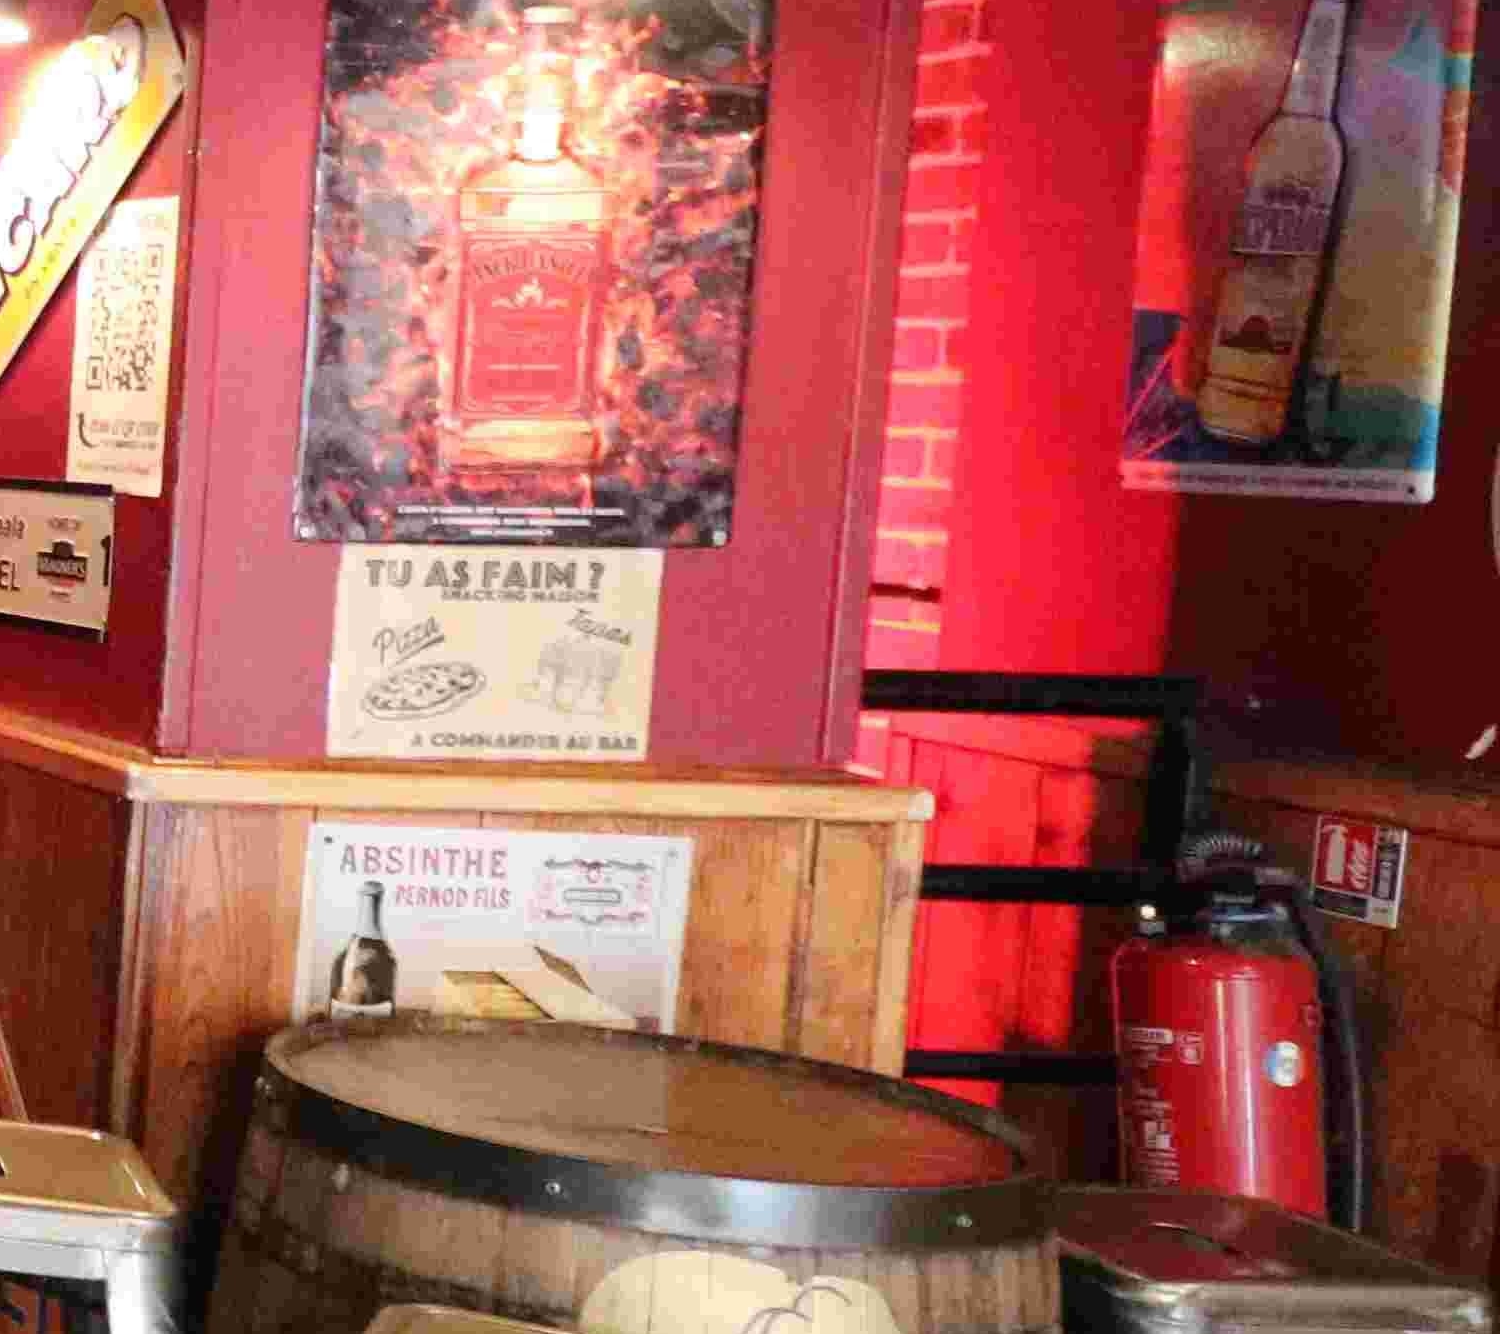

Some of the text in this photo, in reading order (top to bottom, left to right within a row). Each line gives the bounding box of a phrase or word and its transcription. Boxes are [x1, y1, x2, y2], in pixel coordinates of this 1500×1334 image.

[365, 559, 607, 591] TU AS FAIM ?
[372, 616, 442, 665] Pizza
[430, 731, 560, 750] COMMANDER
[566, 733, 593, 750] AU
[599, 734, 638, 752] BAR
[338, 843, 509, 879] ABSINTHE
[395, 883, 511, 909] PERNOD FILS
